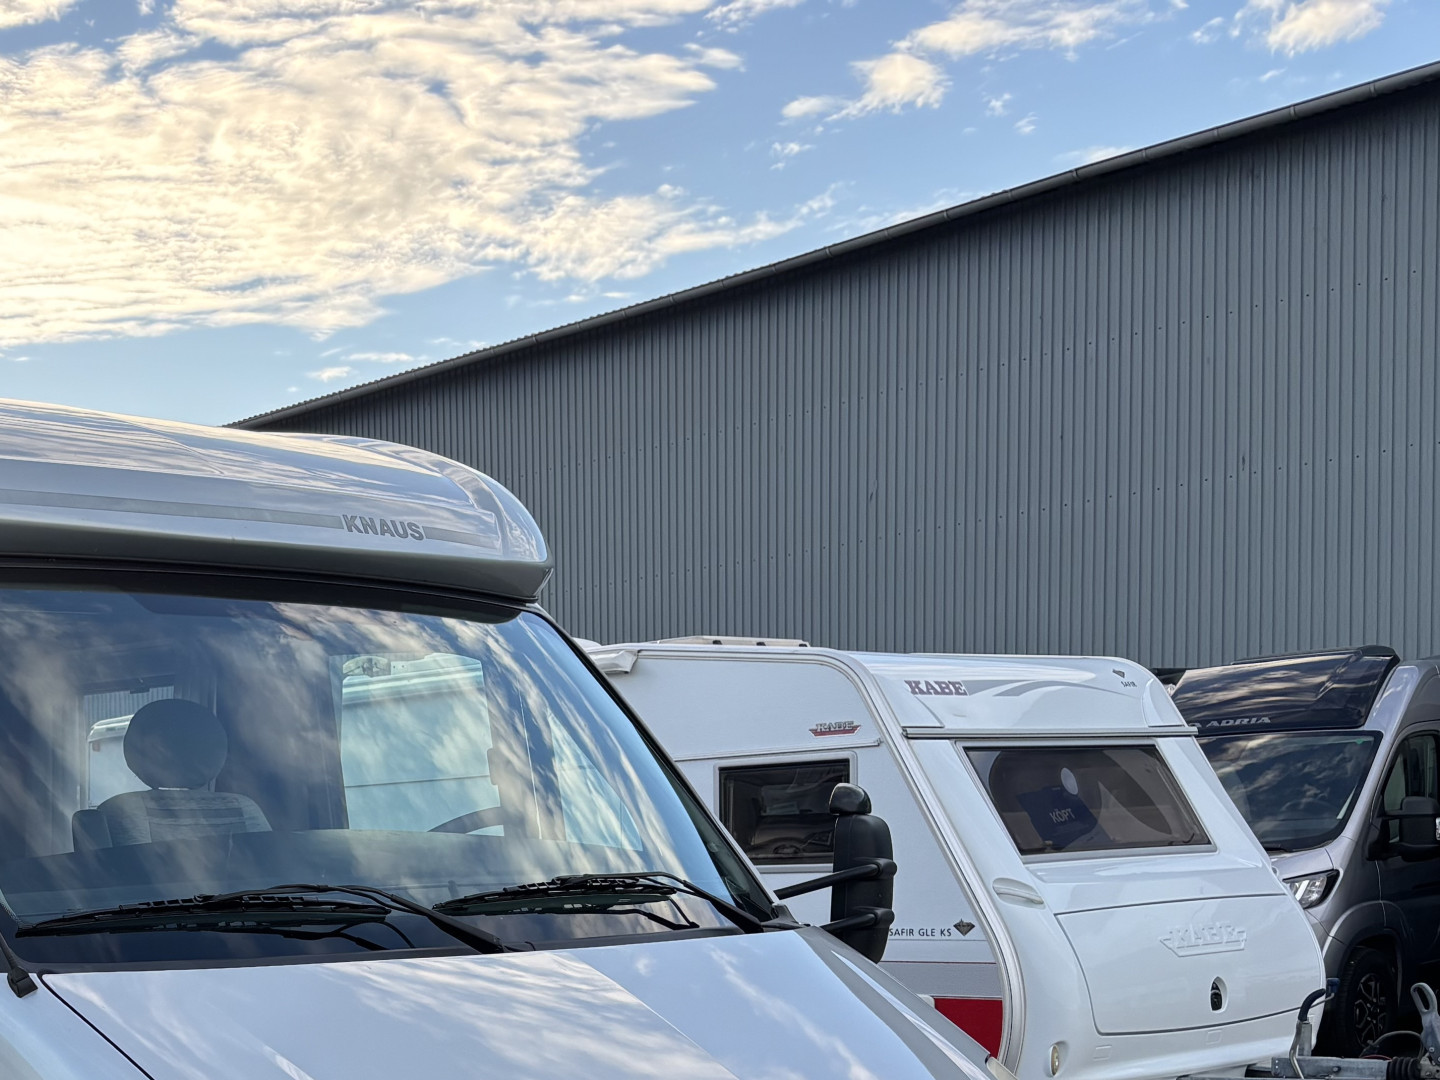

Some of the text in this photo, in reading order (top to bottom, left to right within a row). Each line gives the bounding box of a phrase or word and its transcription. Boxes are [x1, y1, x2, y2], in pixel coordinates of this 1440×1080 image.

[343, 514, 424, 541] KNAUS
[904, 680, 968, 696] KABE
[815, 721, 854, 732] KABE
[1206, 716, 1271, 728] ADRIA
[1049, 808, 1076, 824] KÖPT
[889, 928, 952, 937] SAFIR GLE KS
